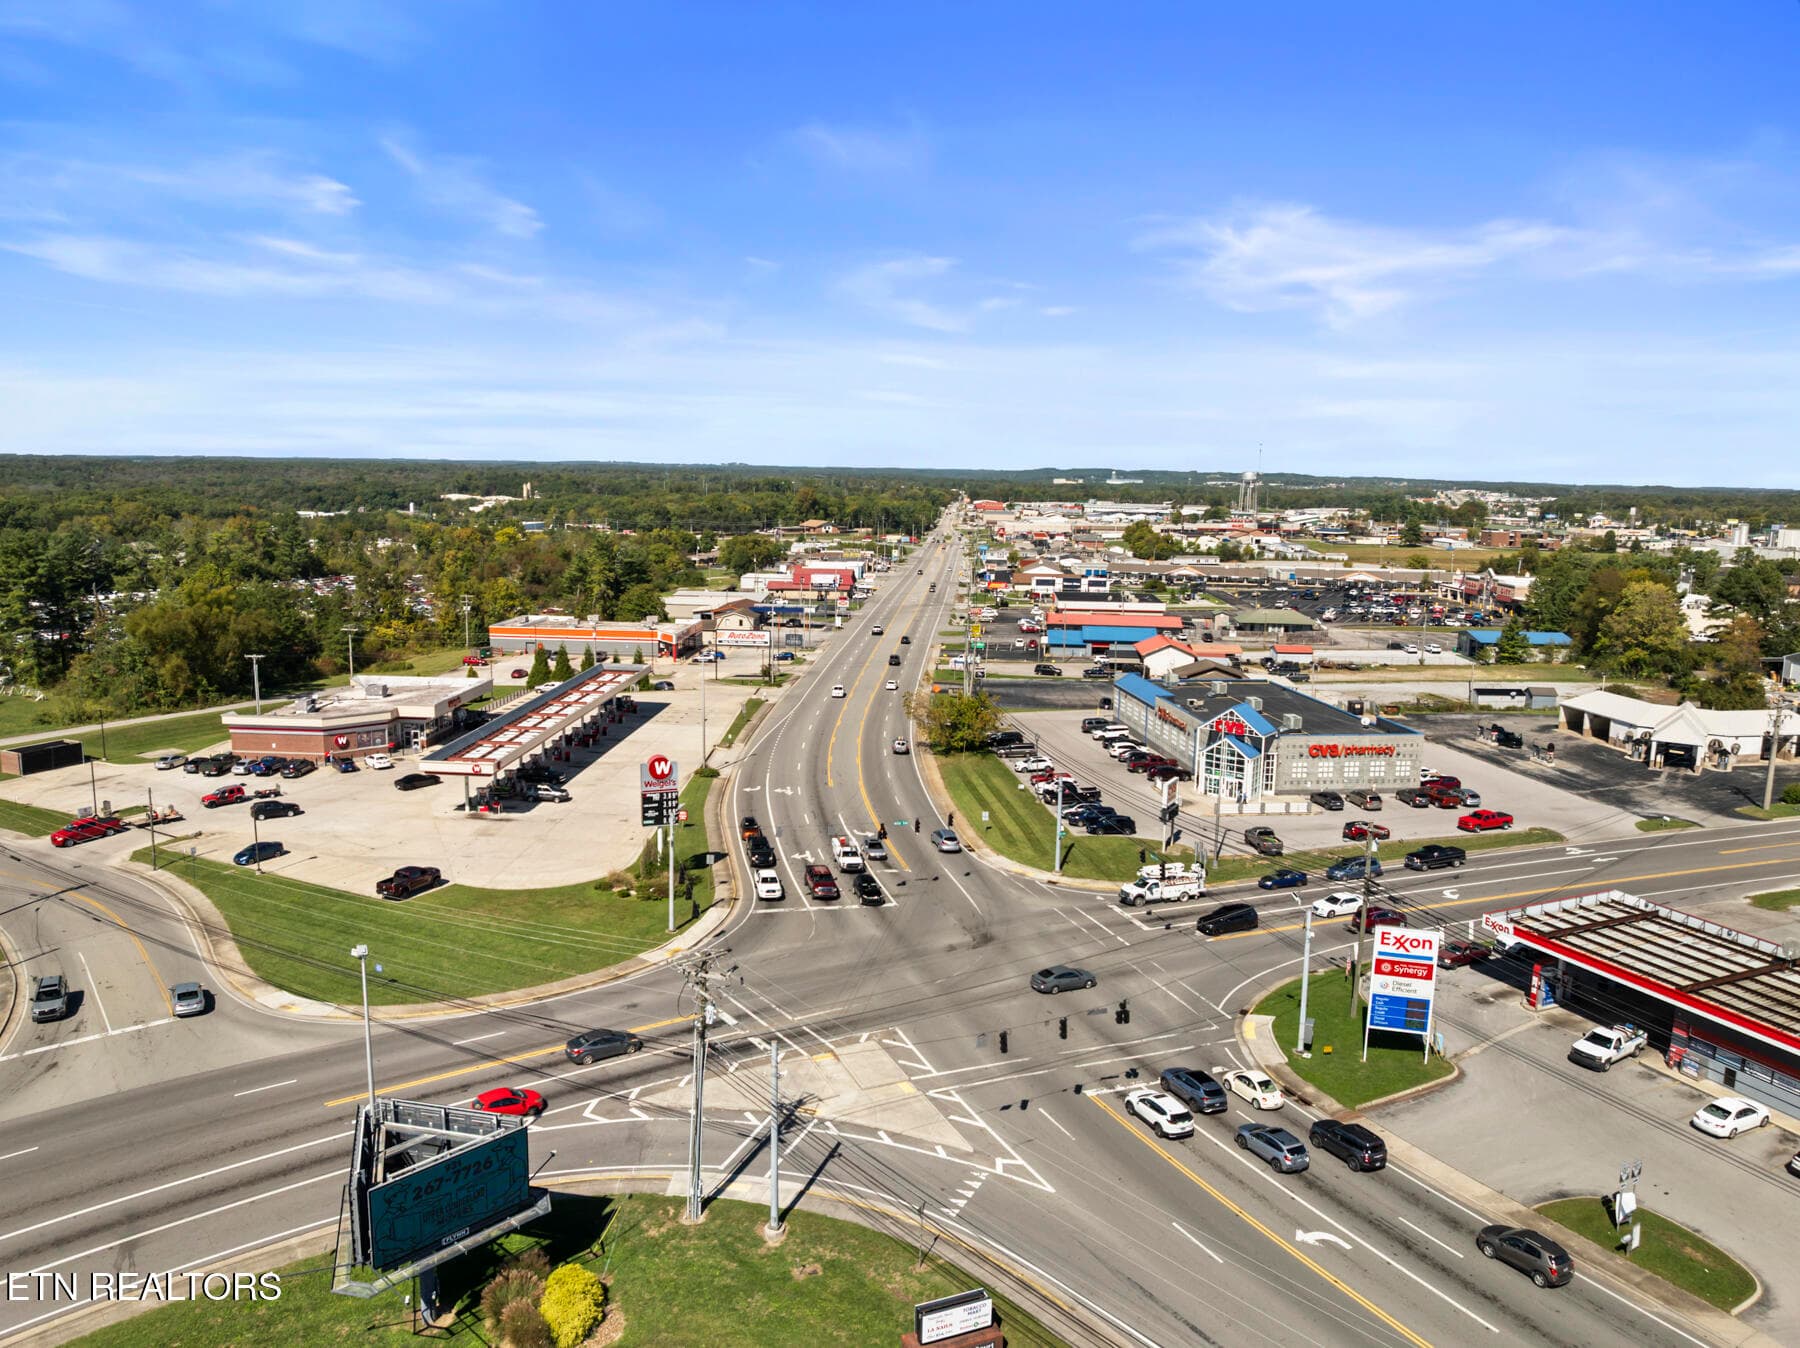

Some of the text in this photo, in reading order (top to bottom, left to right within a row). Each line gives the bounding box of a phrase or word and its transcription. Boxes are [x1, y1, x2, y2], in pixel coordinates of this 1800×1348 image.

[1215, 719, 1245, 735] CVS
[1308, 744, 1396, 758] CVS/pharmacy
[654, 760, 671, 775] W
[643, 779, 677, 788] Weigel's
[1484, 916, 1510, 934] Exxon
[1380, 931, 1433, 953] Exxon
[1393, 964, 1428, 977] Synergy
[1392, 980, 1412, 988] Diesel
[412, 1157, 493, 1201] 267-7726
